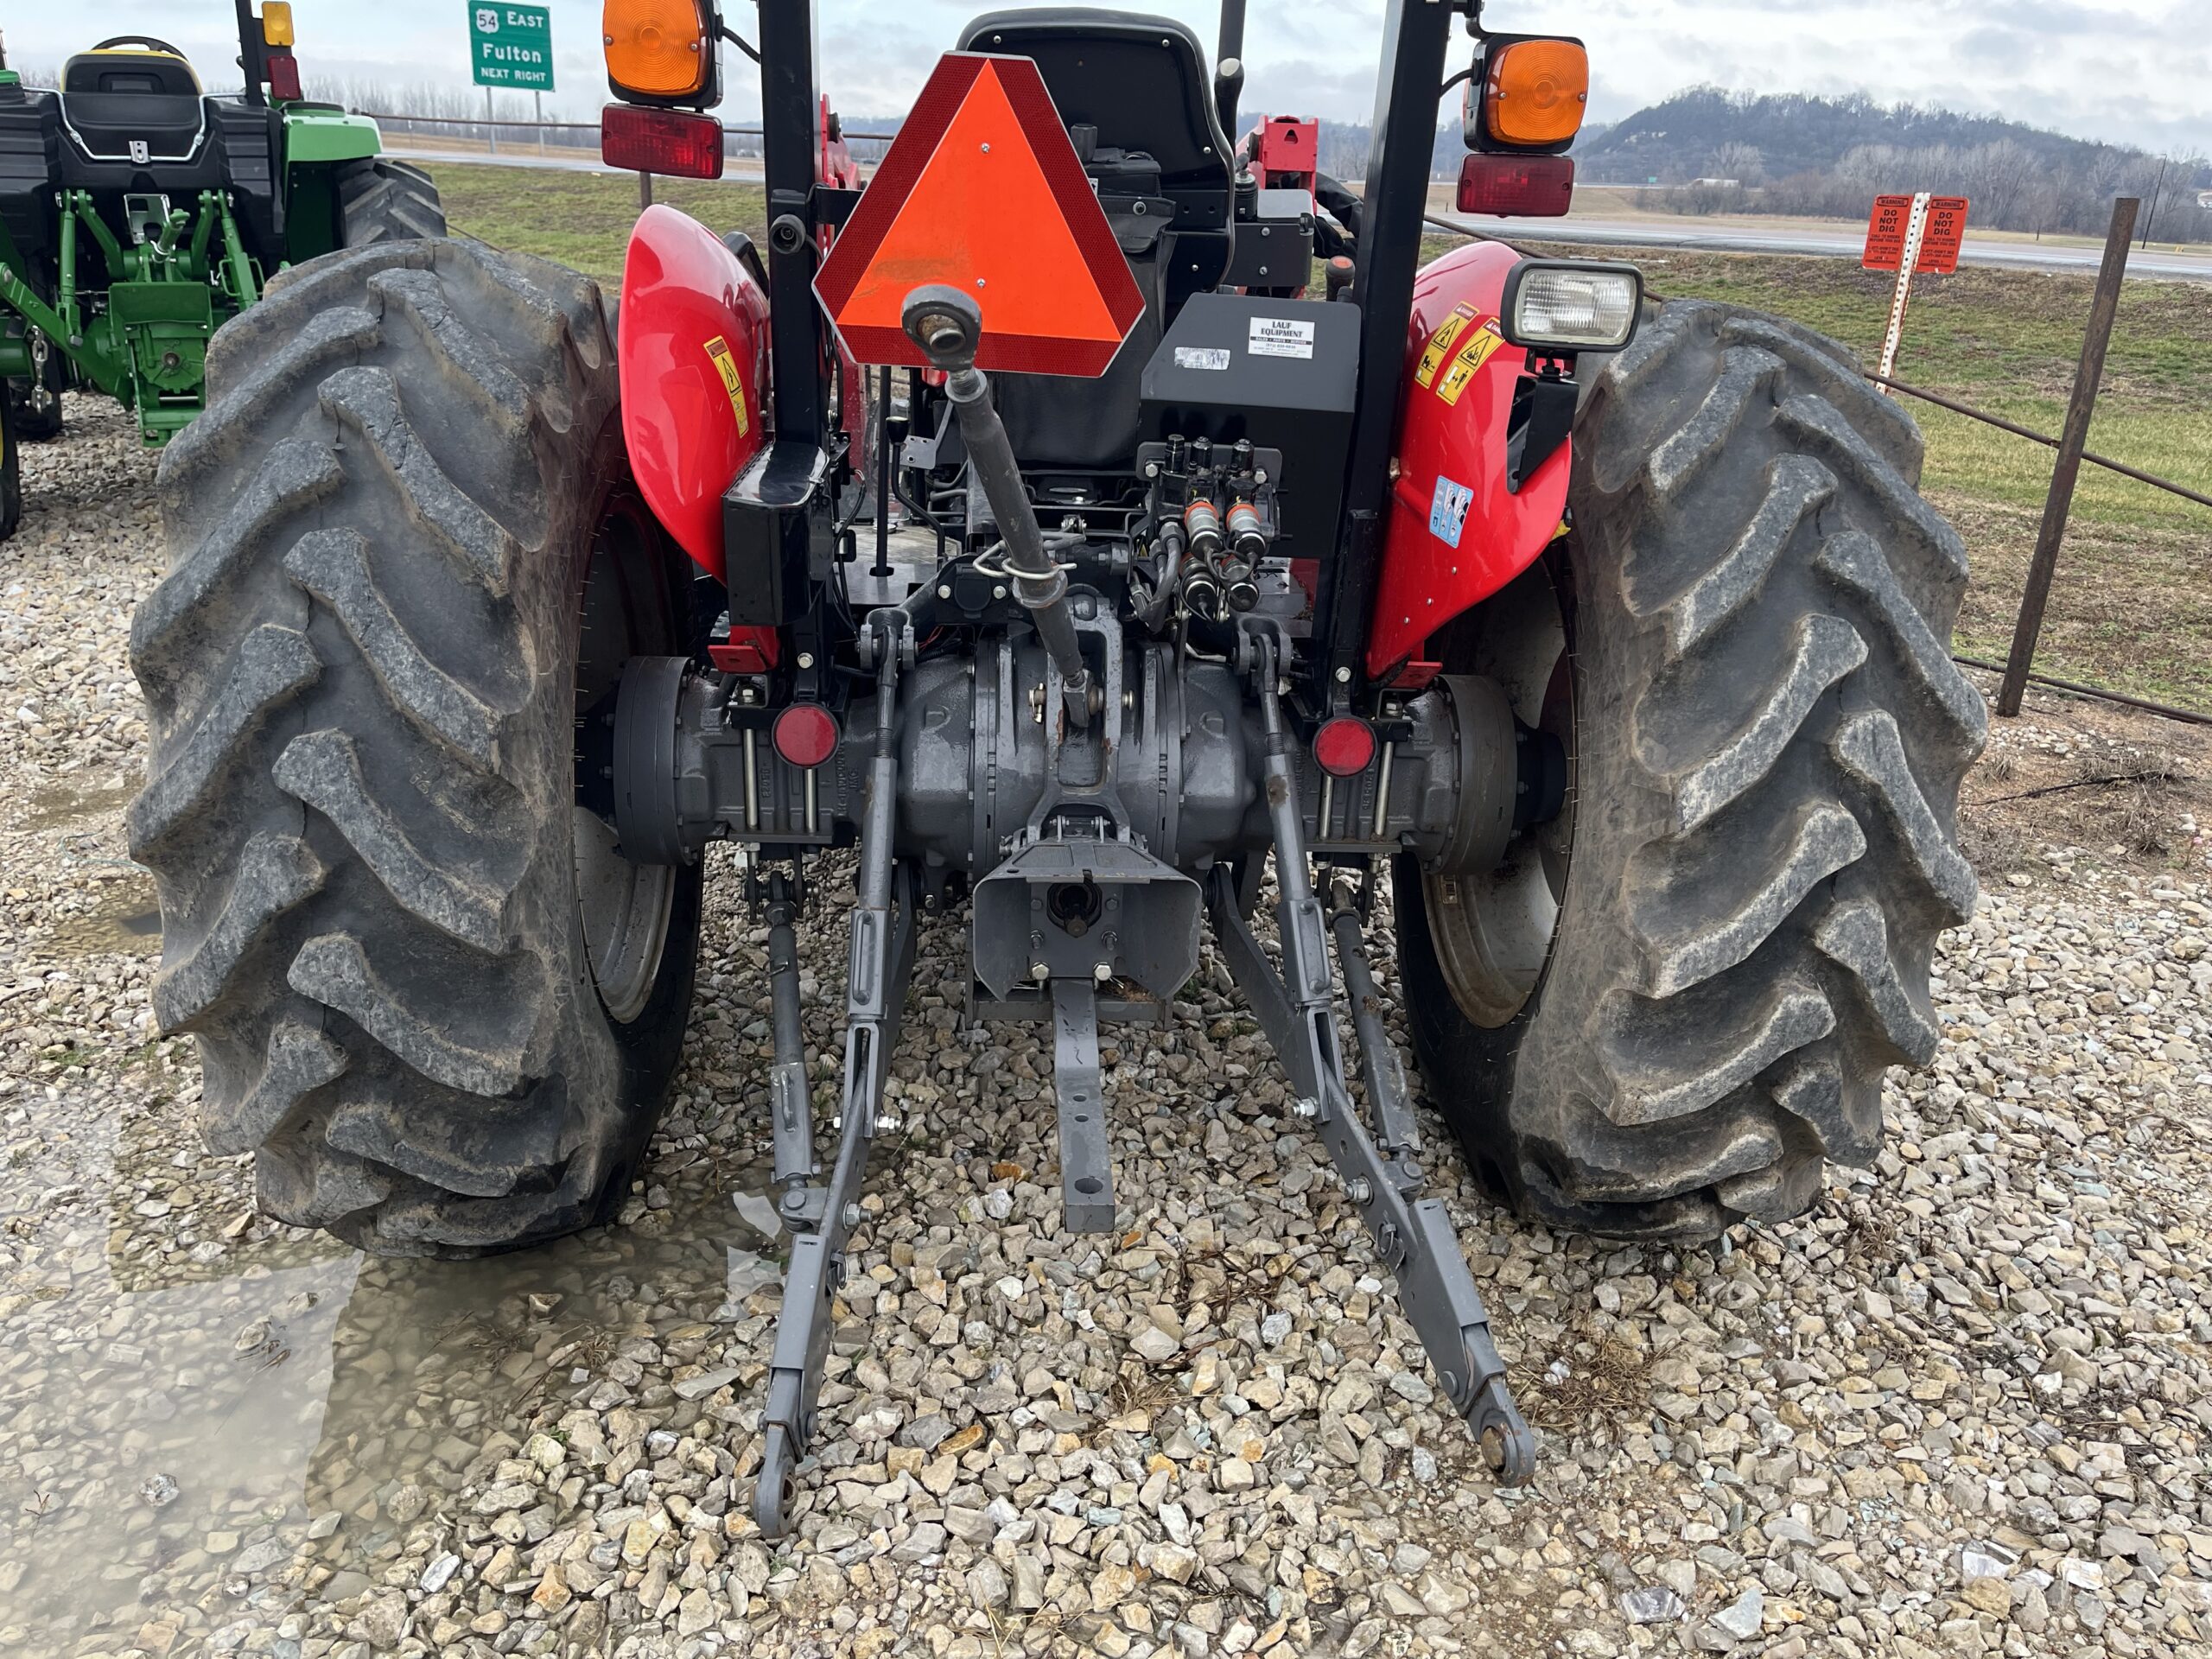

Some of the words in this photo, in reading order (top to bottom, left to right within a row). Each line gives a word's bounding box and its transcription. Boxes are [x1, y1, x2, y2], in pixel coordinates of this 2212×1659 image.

[479, 14, 496, 29] 54
[506, 10, 543, 28] EAST
[482, 42, 542, 63] Fulton
[480, 67, 509, 79] NEXT
[514, 69, 546, 82] RIGHT
[1261, 327, 1303, 338] EQUIPMENT
[1272, 321, 1292, 329] LAUF
